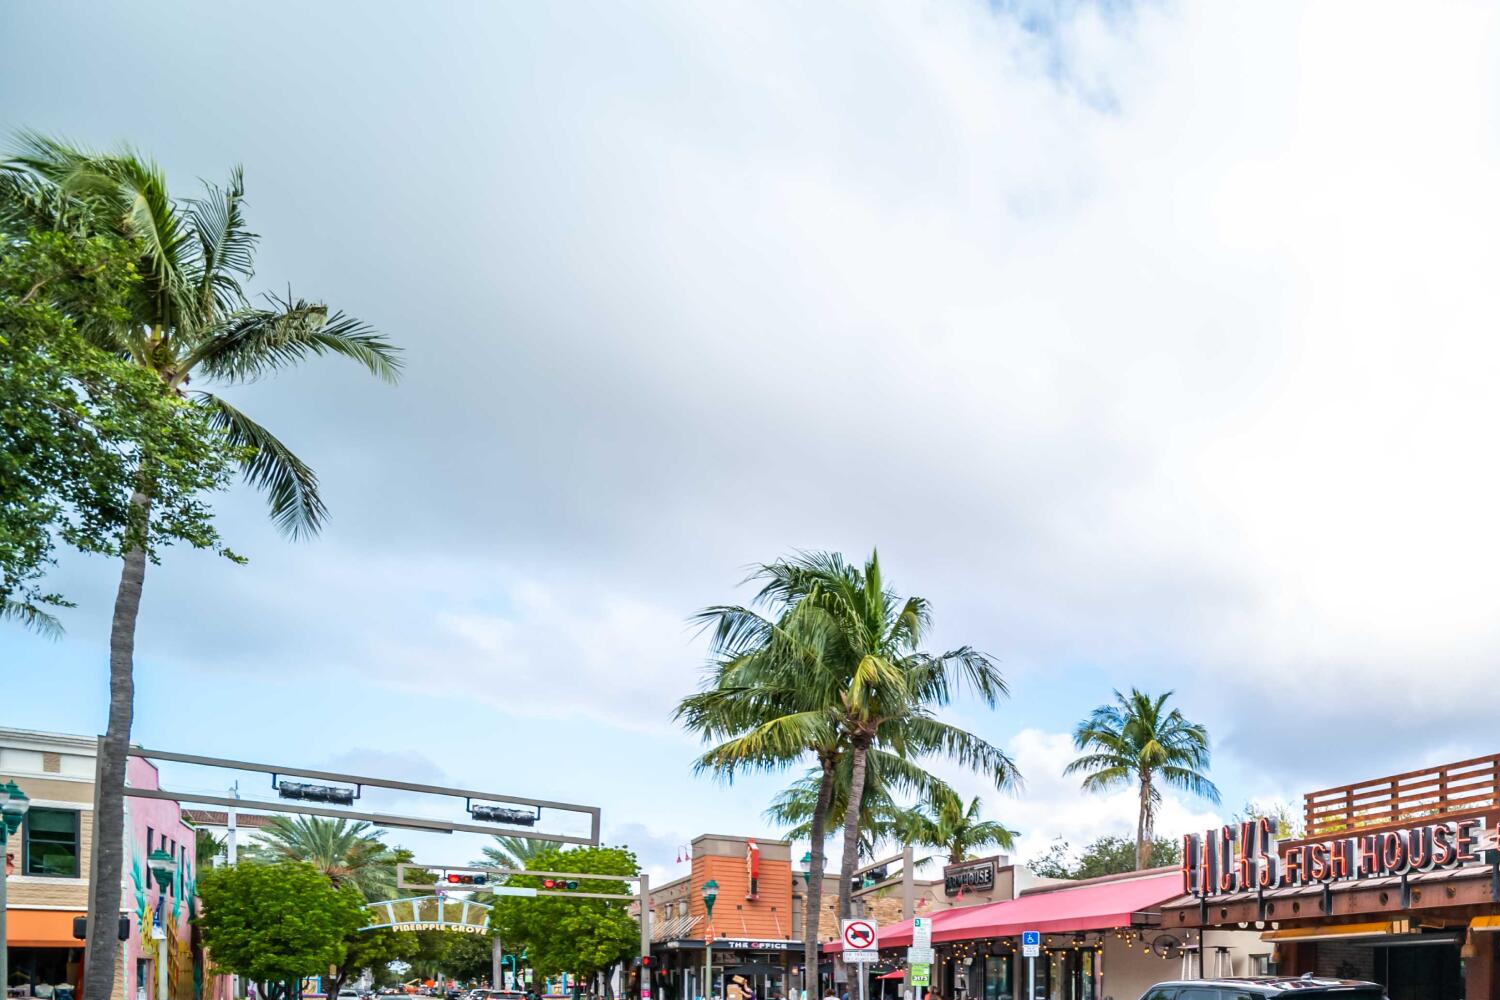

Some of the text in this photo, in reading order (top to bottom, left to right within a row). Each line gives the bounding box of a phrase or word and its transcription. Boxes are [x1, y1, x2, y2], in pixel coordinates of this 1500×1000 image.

[1286, 837, 1357, 888] FISH
[1362, 818, 1486, 877] HOUSE
[392, 923, 488, 935] PINEAPPLE GROVE
